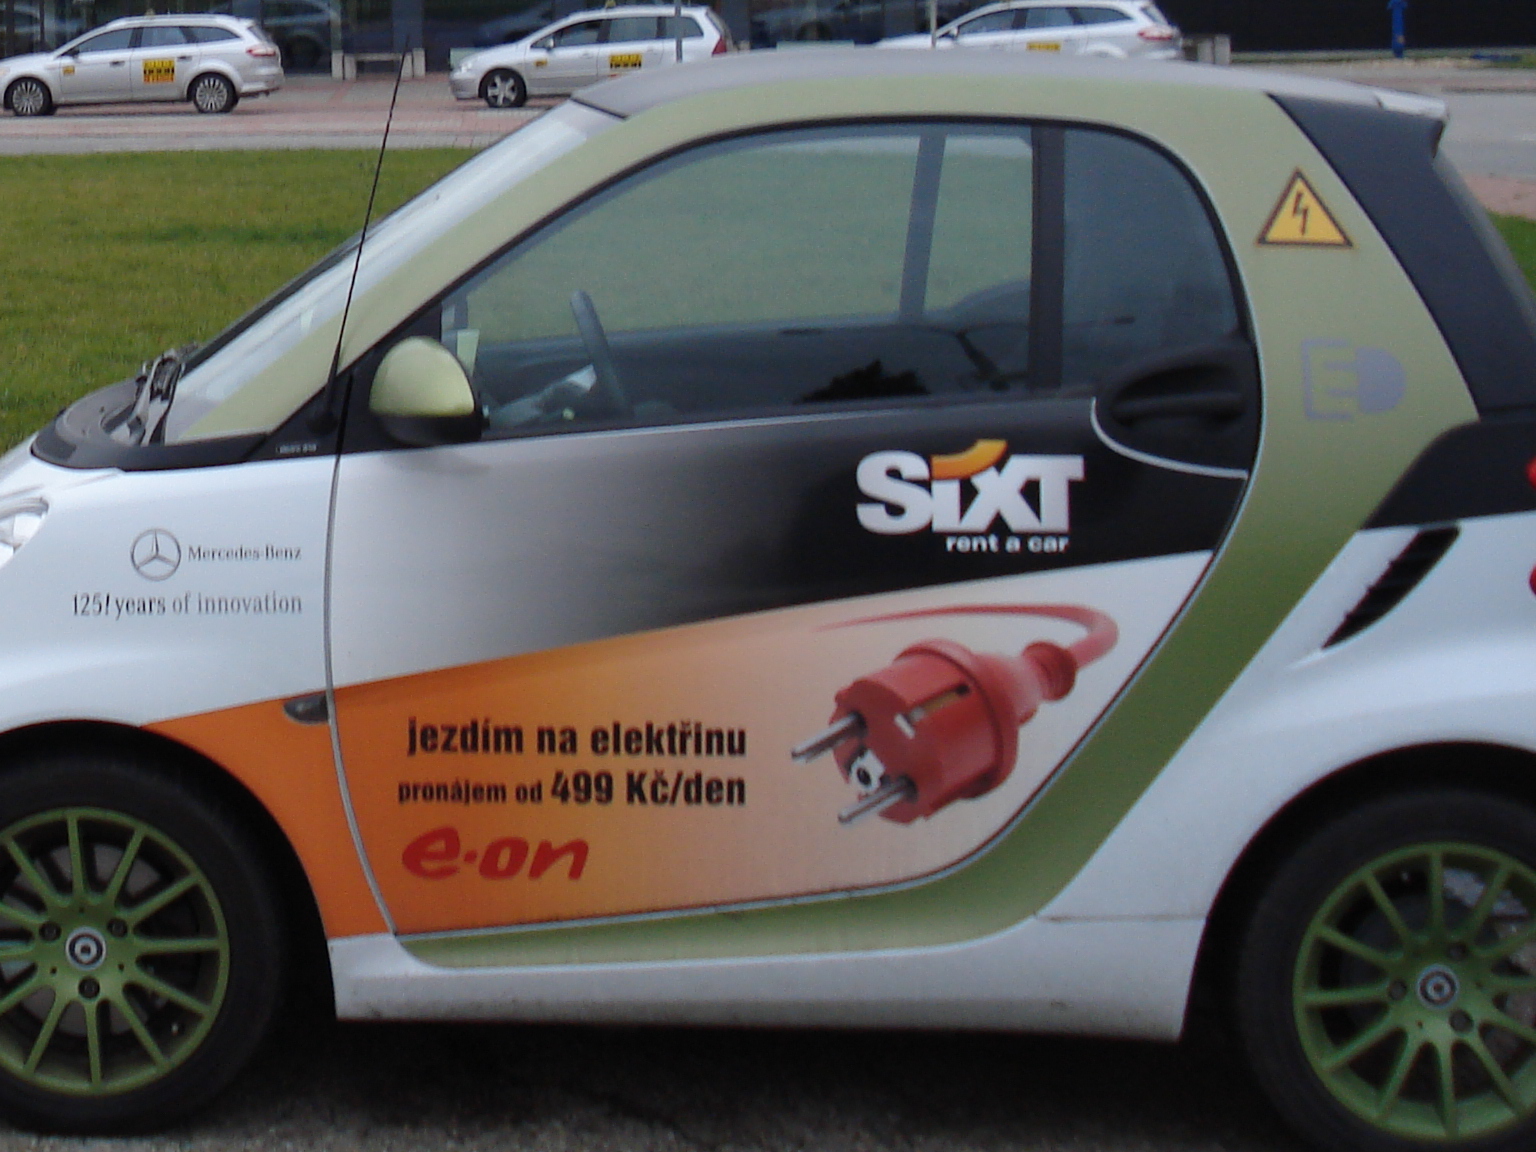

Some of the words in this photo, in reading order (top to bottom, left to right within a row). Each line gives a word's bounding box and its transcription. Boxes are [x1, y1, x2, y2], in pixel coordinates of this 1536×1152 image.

[945, 534, 1000, 553] rent
[1005, 536, 1021, 553] a
[1027, 536, 1070, 553] car
[115, 595, 166, 622] years
[172, 590, 192, 615] of
[197, 590, 303, 615] innovation
[536, 725, 578, 756] na
[398, 777, 507, 806] pronájem
[515, 779, 543, 804] od
[551, 770, 614, 805] 499
[626, 769, 747, 806] Kč/den
